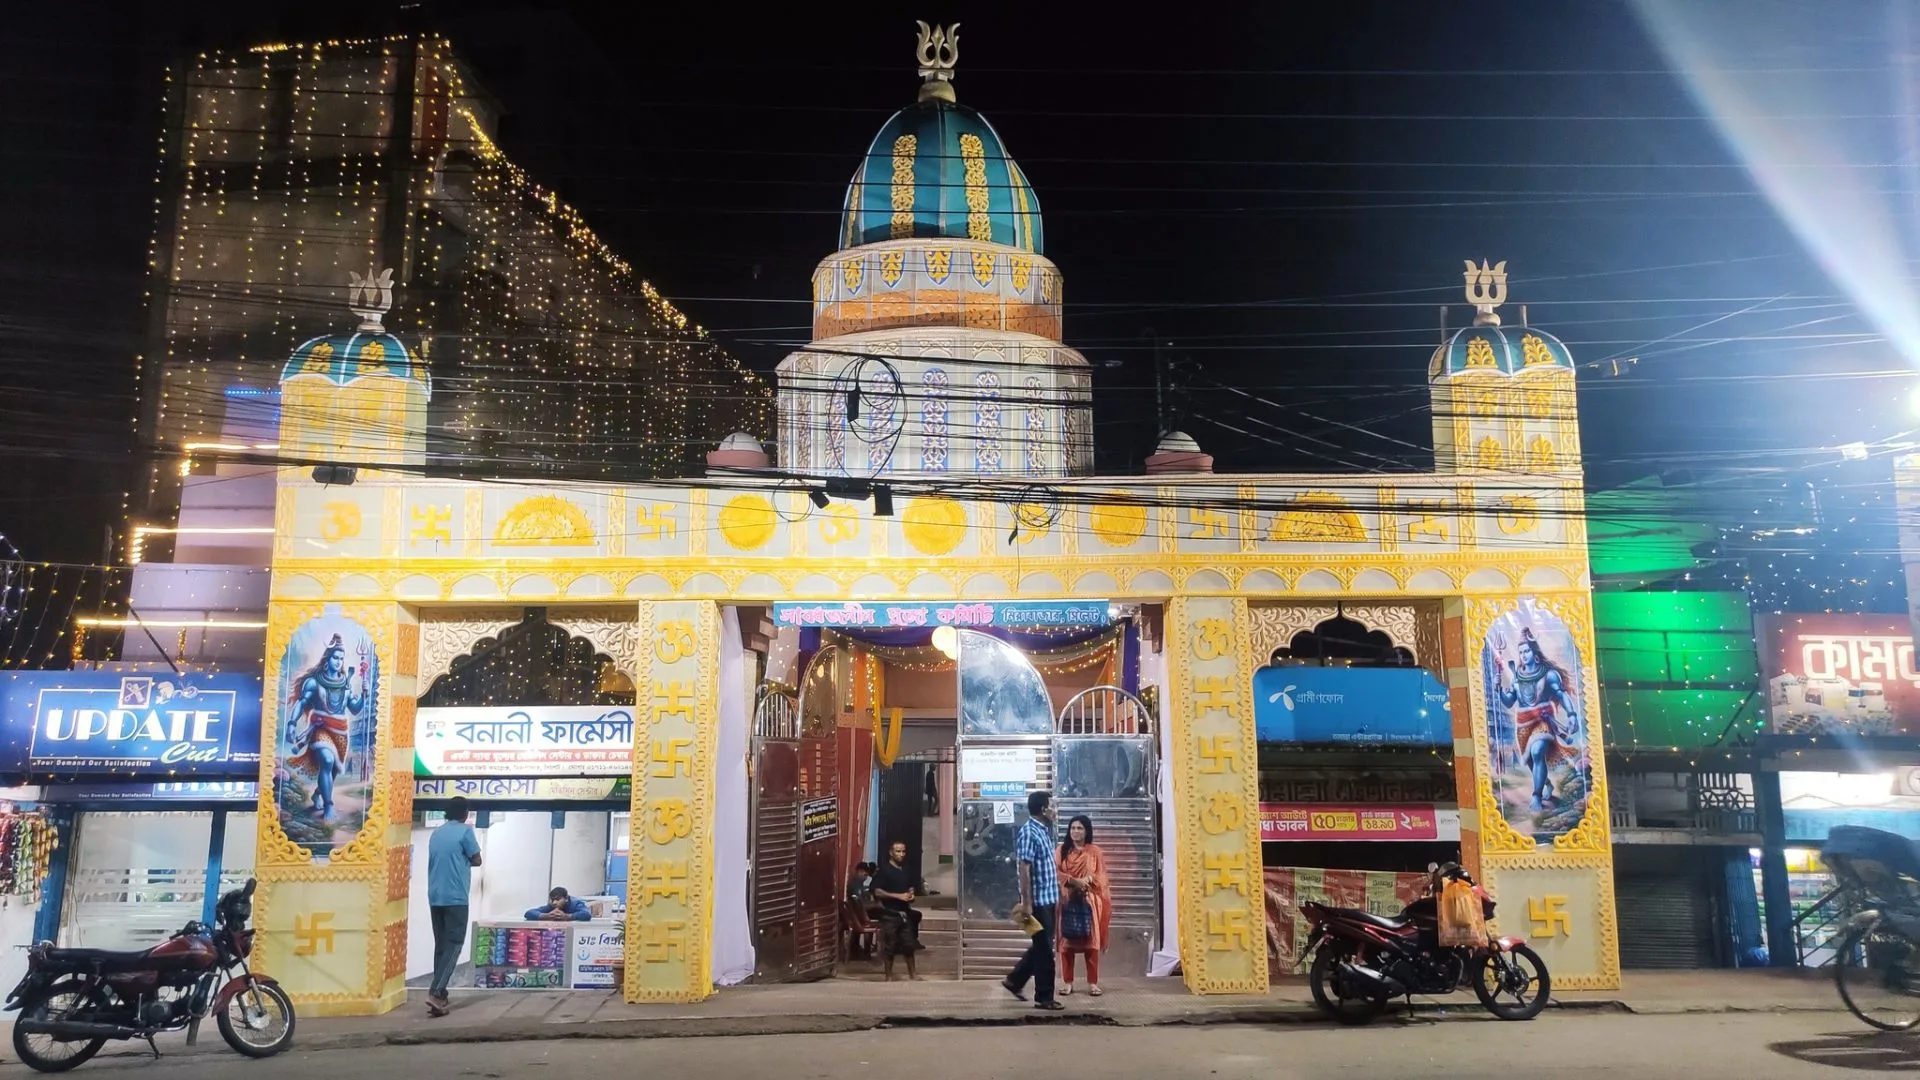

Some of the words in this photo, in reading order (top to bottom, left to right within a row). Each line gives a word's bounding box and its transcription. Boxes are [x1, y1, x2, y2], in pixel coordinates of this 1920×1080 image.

[936, 604, 995, 625] কমিটি
[1296, 690, 1344, 704] গ্রামীণফোন
[46, 709, 220, 742] UPDATE
[454, 711, 533, 744] বনানী
[541, 711, 634, 744] ফার্মেসী
[161, 742, 219, 764] Cut
[1276, 820, 1308, 831] ডাবল
[1314, 814, 1336, 829] ৫০
[1366, 819, 1394, 829] ১৪.৯০
